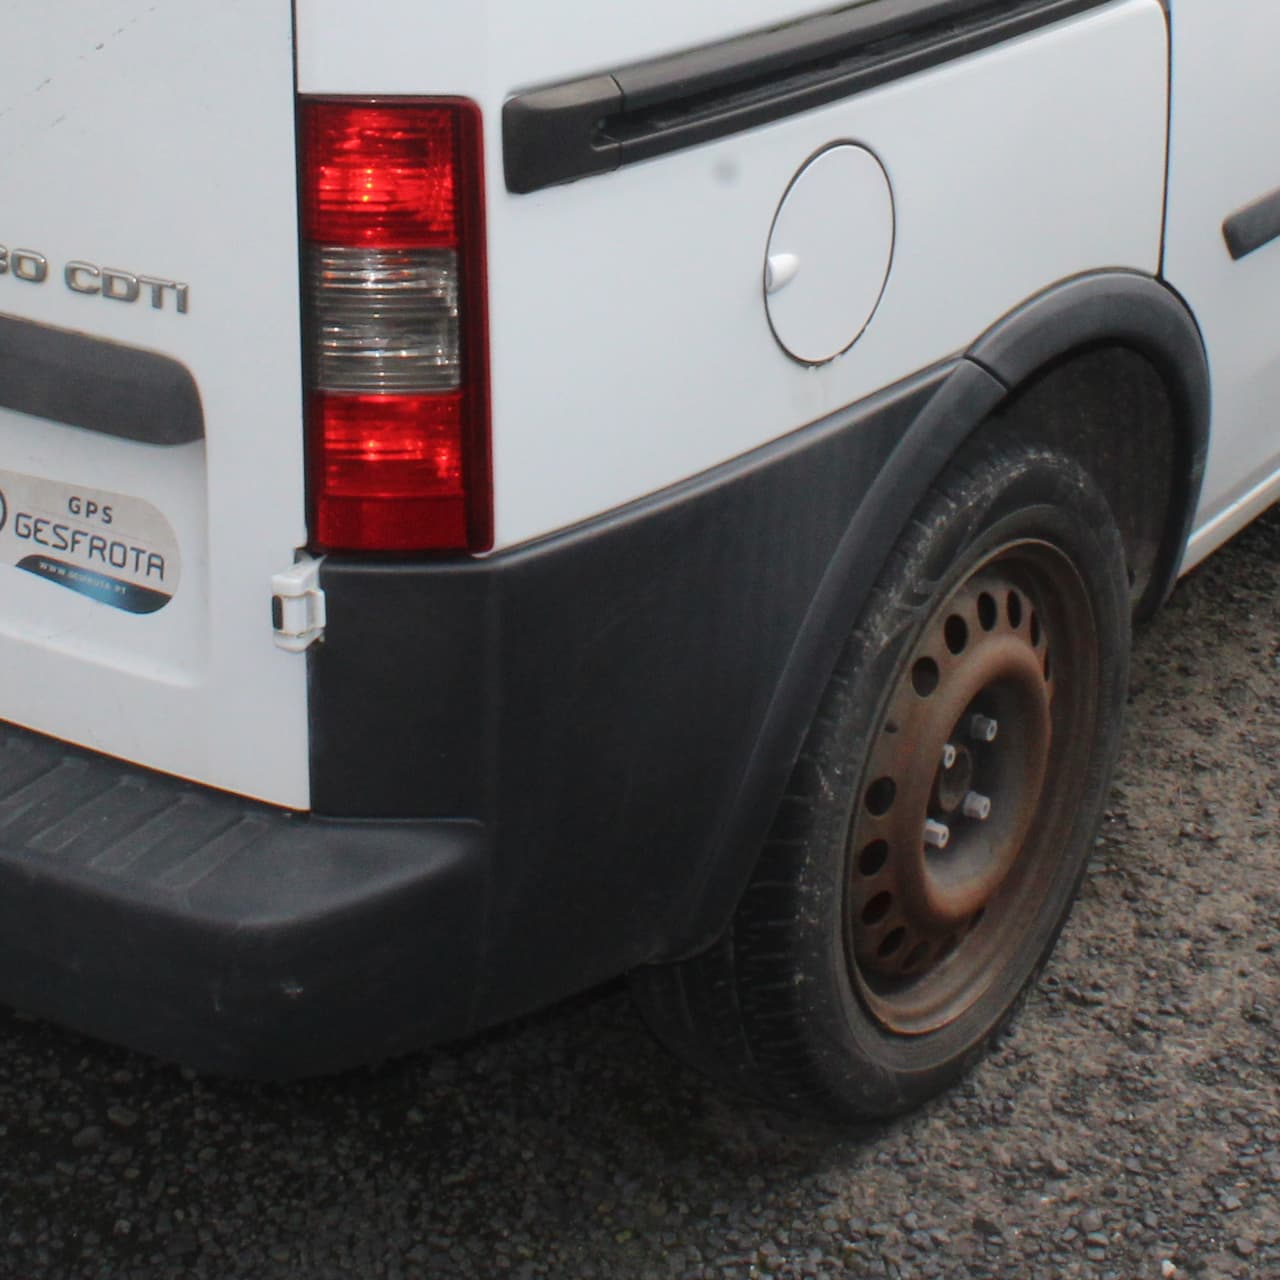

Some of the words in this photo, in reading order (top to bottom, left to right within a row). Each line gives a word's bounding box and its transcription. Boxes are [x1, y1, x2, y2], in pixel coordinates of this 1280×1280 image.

[64, 260, 189, 315] CDTI
[68, 495, 114, 524] GPS
[14, 512, 165, 582] GESFROTA
